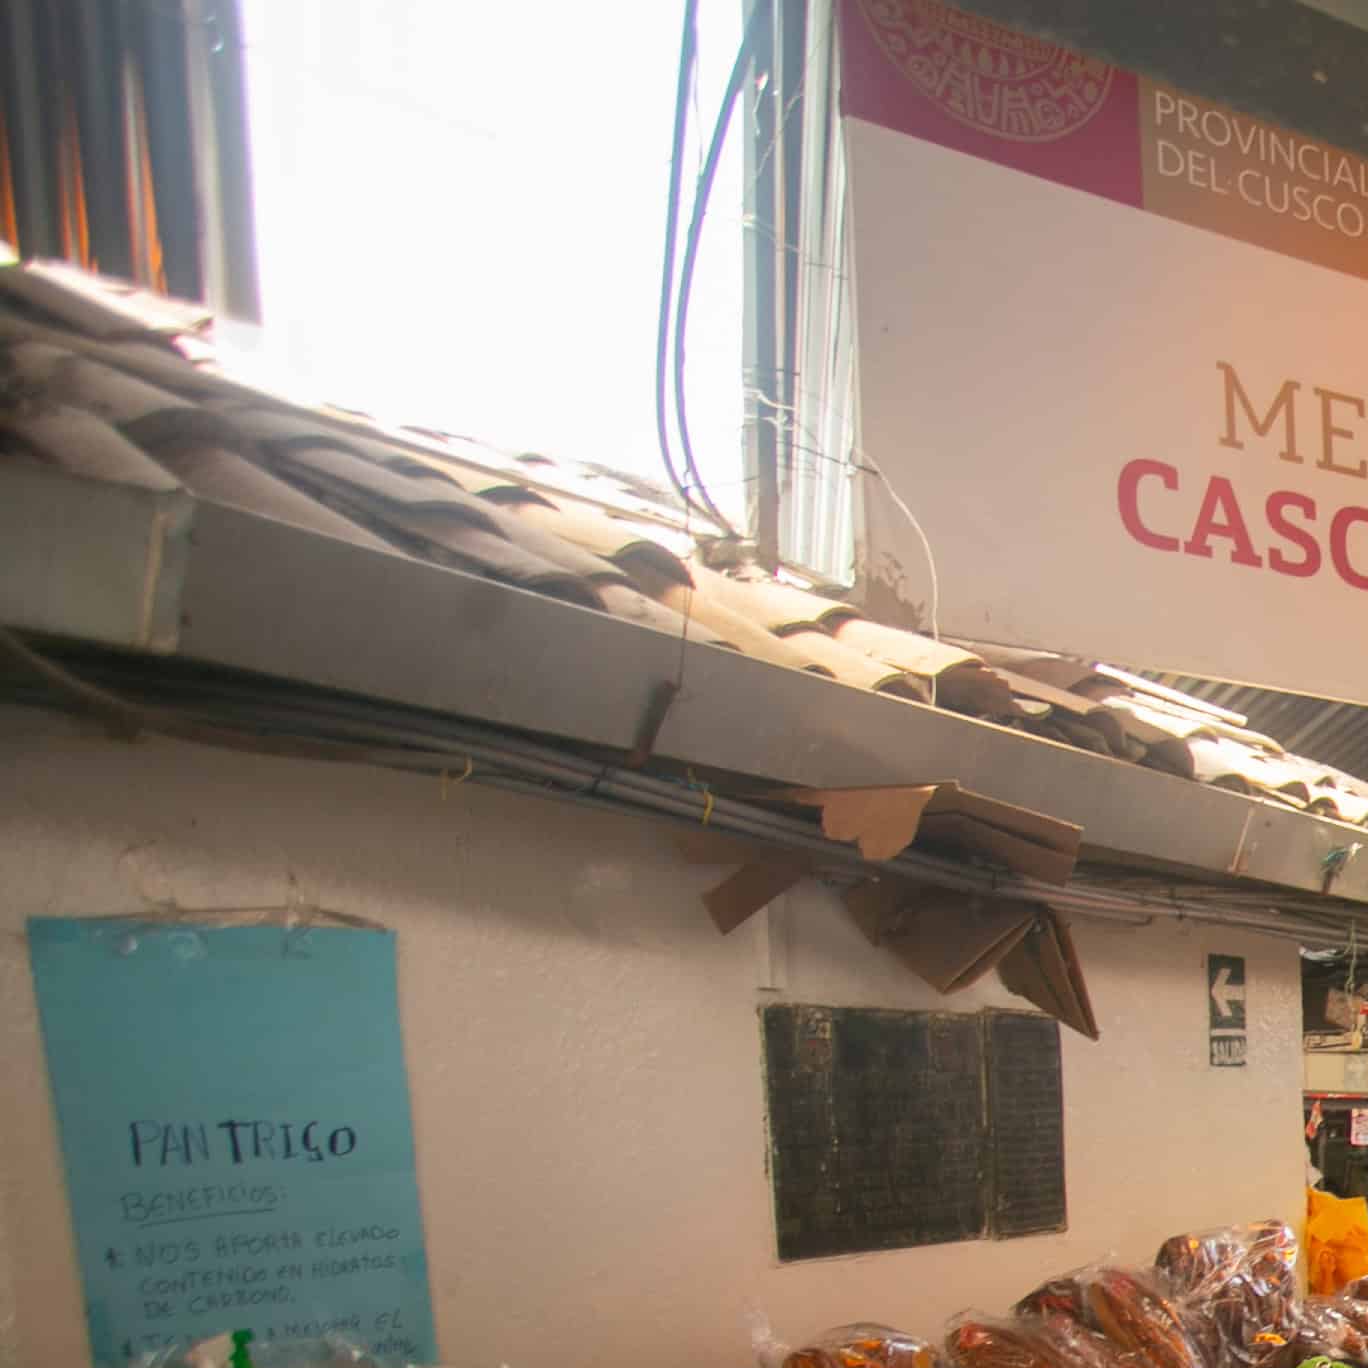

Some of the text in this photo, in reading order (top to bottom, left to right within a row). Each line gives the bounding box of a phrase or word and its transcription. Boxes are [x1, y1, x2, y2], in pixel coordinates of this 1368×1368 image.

[1156, 139, 1366, 240] DEL CUSCO
[129, 1118, 358, 1167] PAN TRIGO
